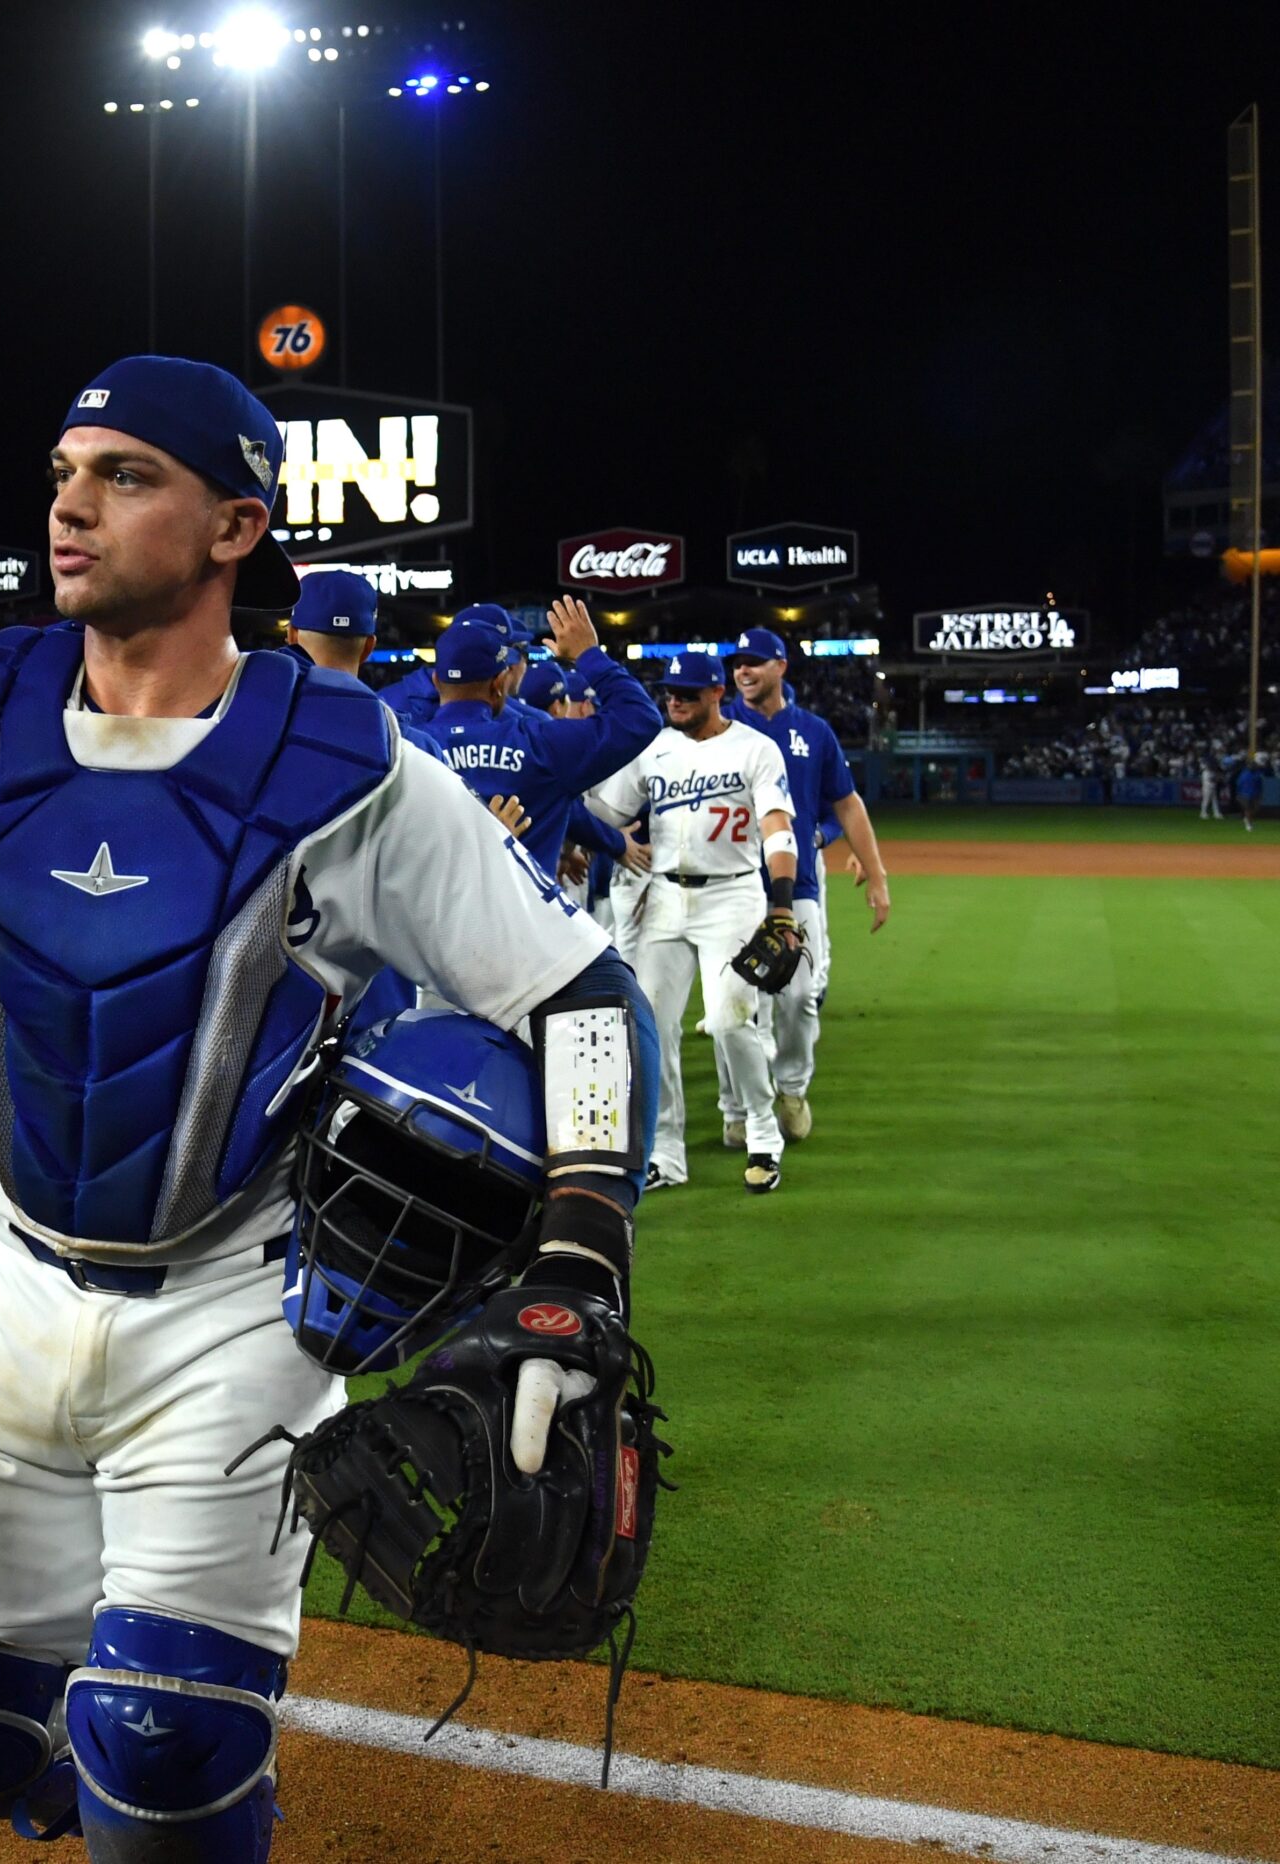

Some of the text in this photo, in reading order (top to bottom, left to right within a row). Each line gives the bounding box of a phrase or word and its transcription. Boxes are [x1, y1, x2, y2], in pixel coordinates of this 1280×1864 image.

[272, 322, 312, 354] 76
[276, 415, 440, 524] IN!
[737, 545, 848, 566] UCLA Health
[929, 630, 1043, 650] JALISCO
[789, 728, 809, 757] LA
[442, 744, 525, 773] ANGELES
[647, 769, 746, 815] Dodgers
[707, 806, 751, 842] 72
